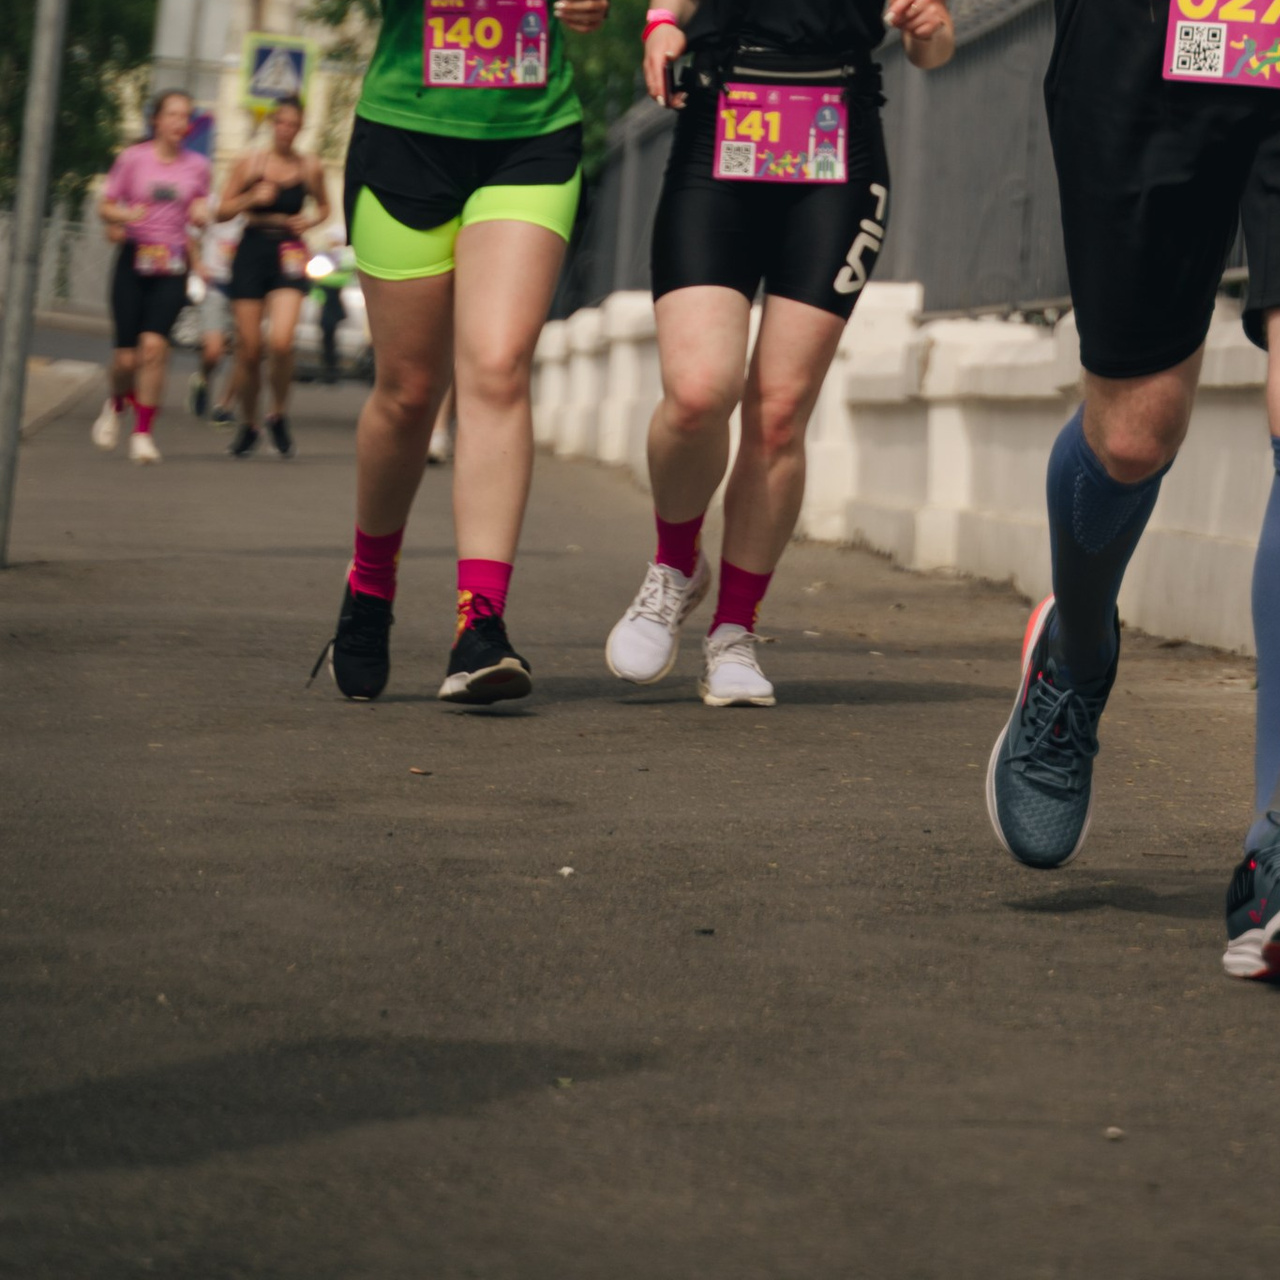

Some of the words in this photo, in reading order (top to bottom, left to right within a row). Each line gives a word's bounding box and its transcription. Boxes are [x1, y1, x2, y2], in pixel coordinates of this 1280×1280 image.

[428, 17, 503, 49] 140
[721, 109, 781, 143] 141
[833, 183, 887, 295] FILA
